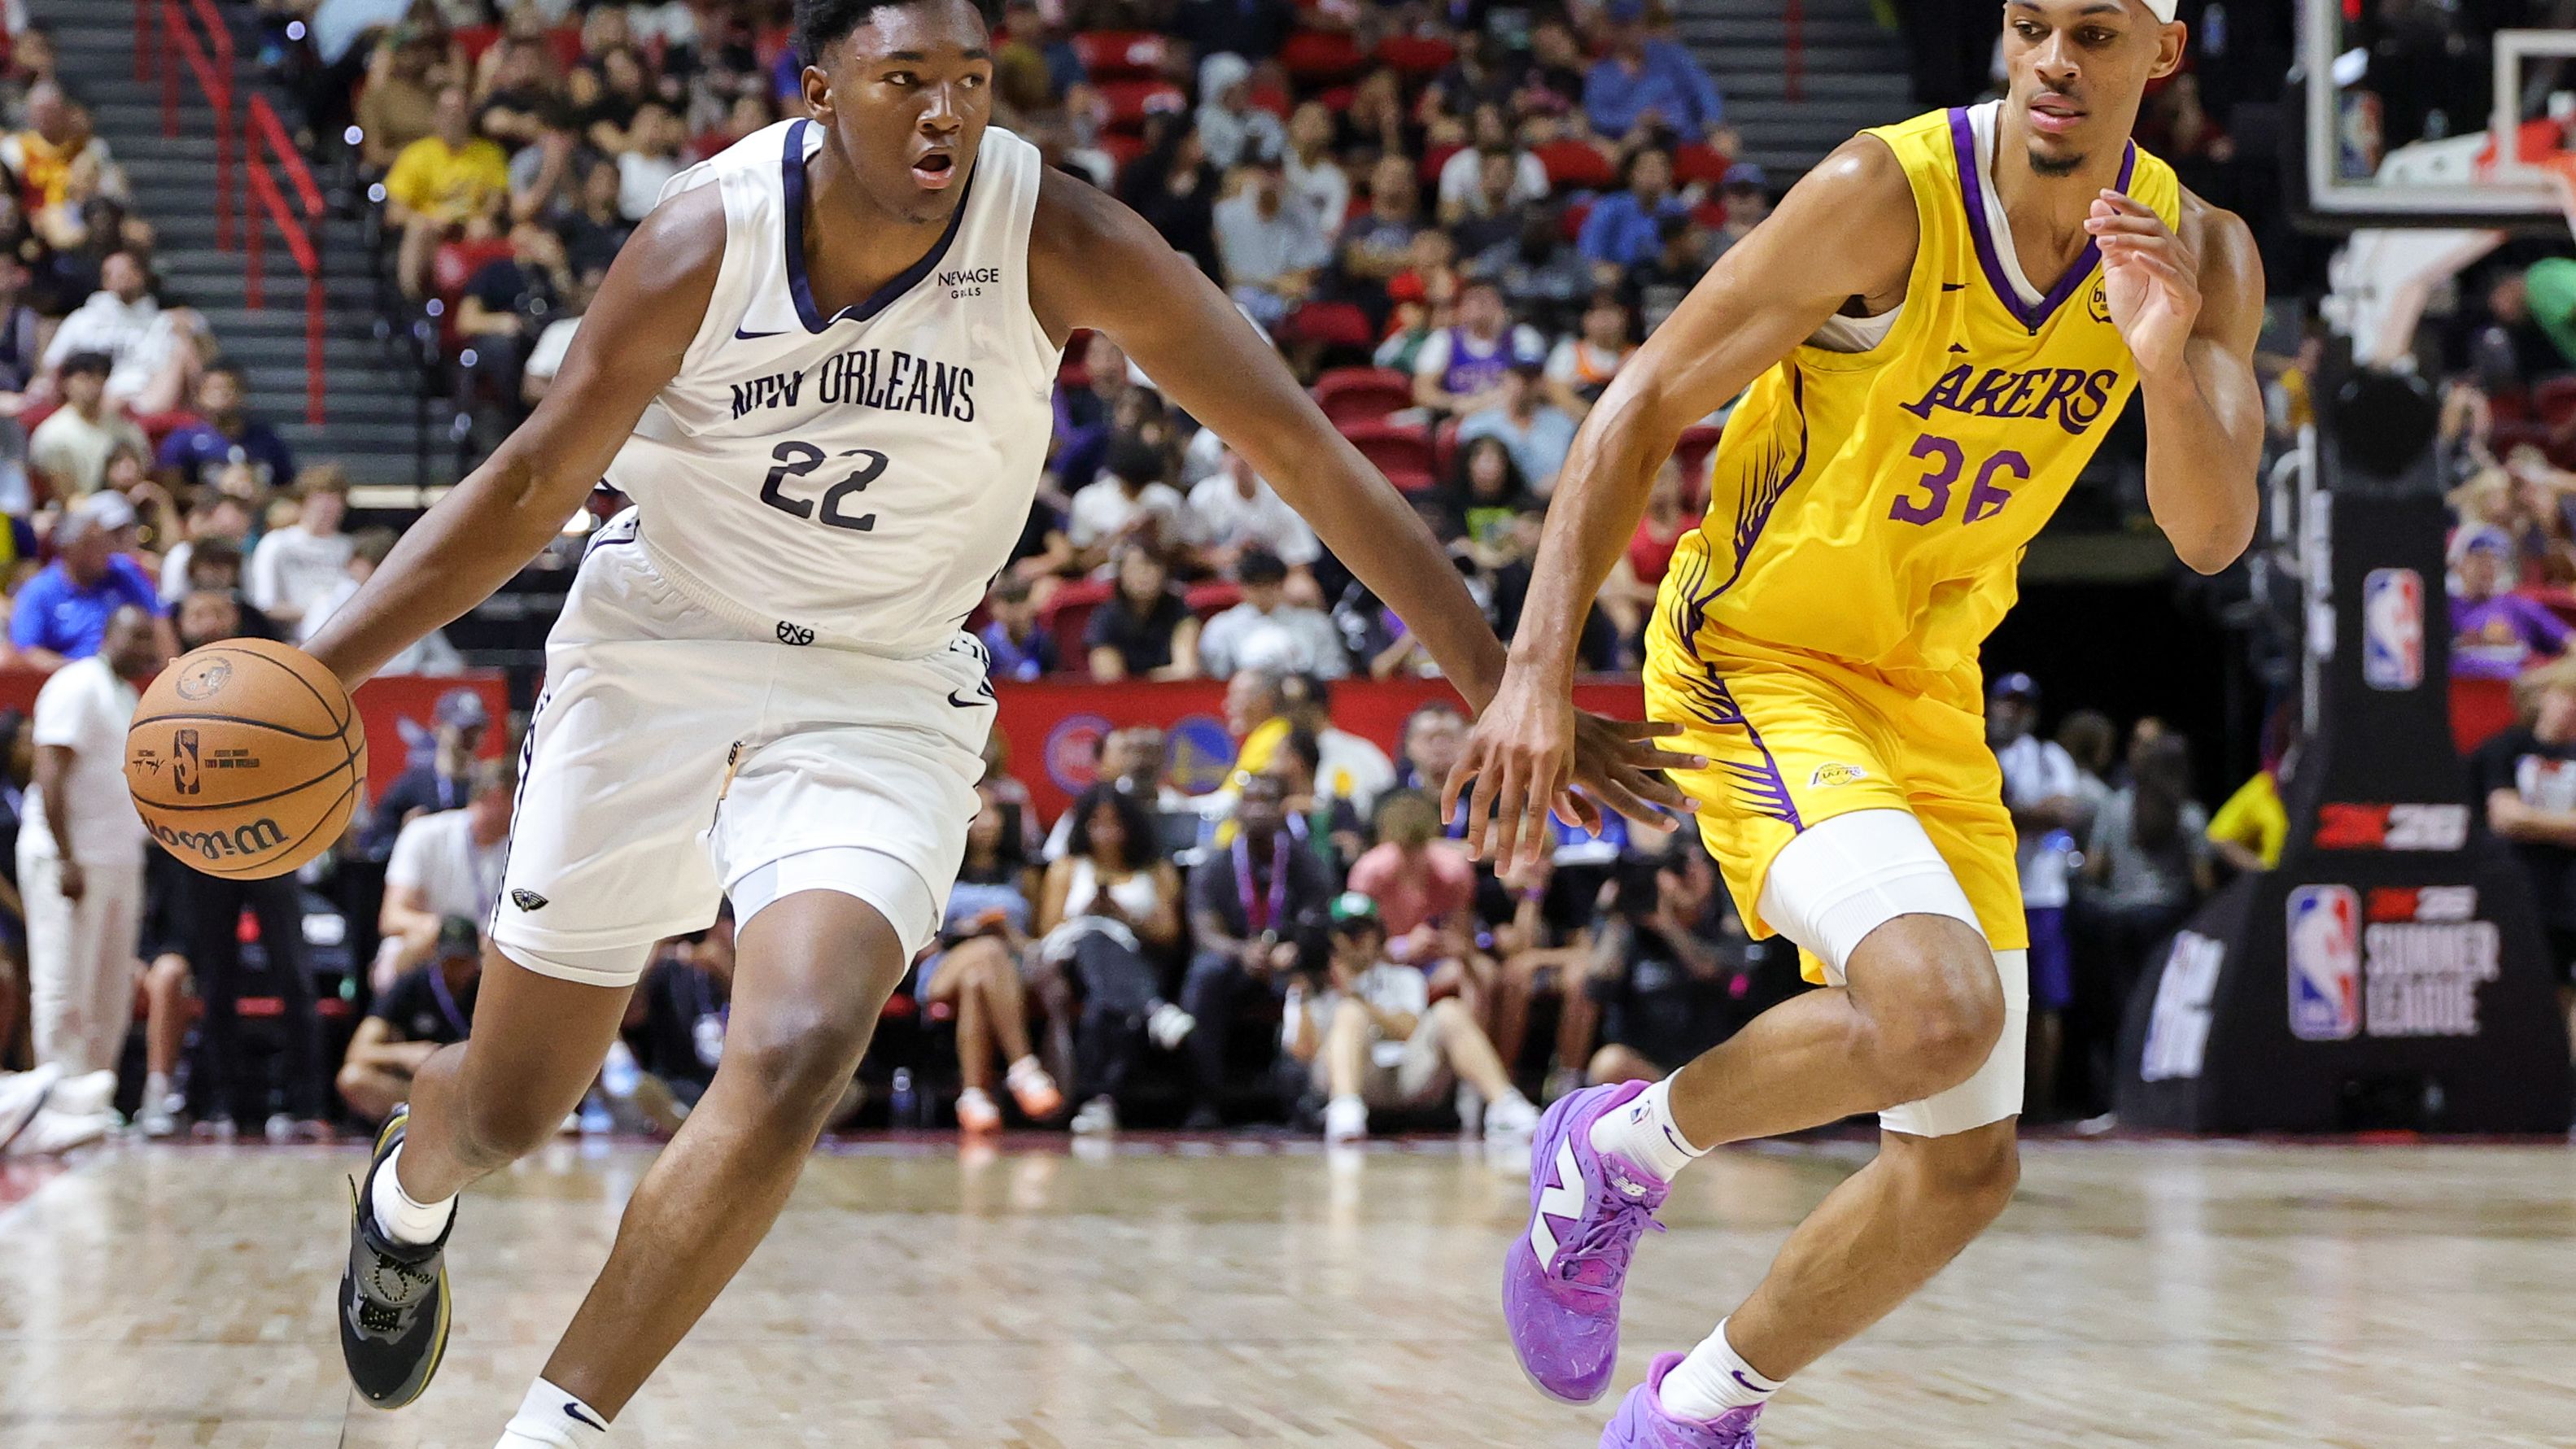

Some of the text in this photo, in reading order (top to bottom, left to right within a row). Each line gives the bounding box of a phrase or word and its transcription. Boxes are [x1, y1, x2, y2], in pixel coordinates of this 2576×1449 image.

[938, 268, 998, 286] NEWAGE
[730, 349, 974, 422] NEW ORLEANS
[760, 440, 889, 531] 22
[1888, 433, 2031, 526] 36
[141, 814, 289, 860] Wilson
[2365, 921, 2500, 980] SUMMER
[2365, 976, 2480, 1036] LEAGUE
